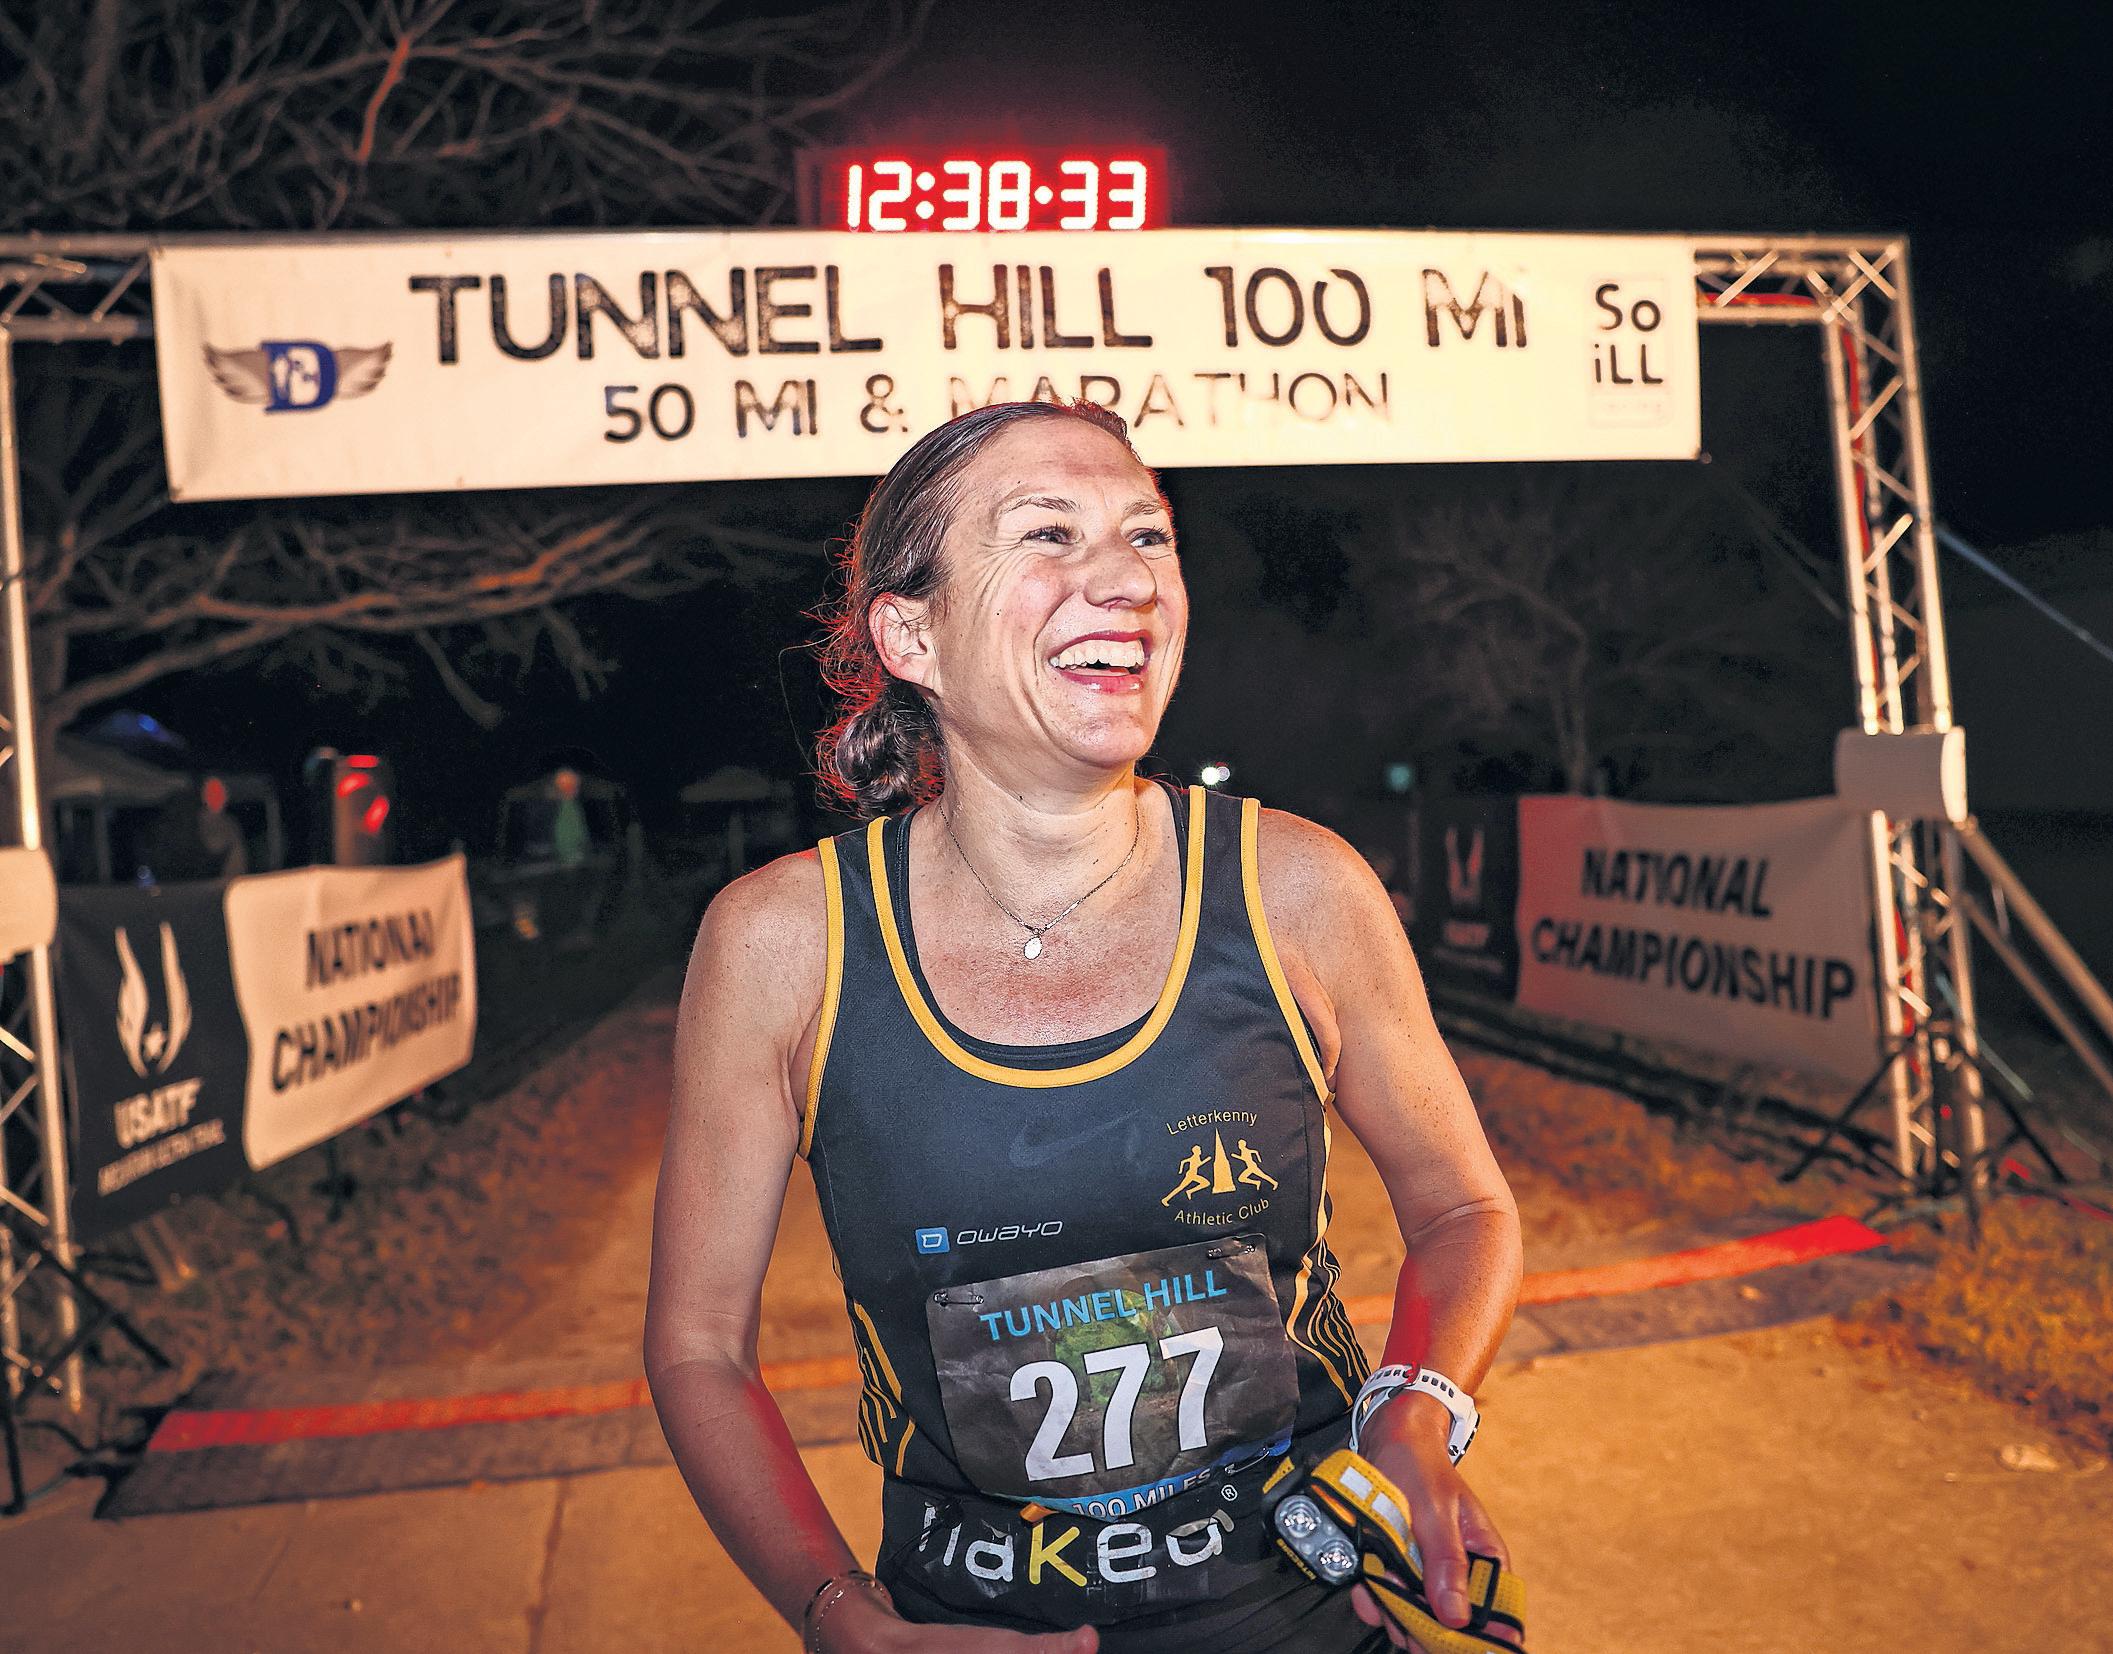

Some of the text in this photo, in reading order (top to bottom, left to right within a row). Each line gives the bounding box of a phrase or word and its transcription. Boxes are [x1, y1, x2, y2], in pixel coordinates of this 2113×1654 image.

[408, 263, 884, 366] TUNNEL
[937, 262, 1153, 350] HILL
[1204, 264, 1371, 349] 100
[1594, 283, 1662, 333] So
[604, 382, 695, 443] 50
[733, 377, 820, 439] MI
[859, 373, 908, 436] &
[1581, 846, 1775, 920] NATIONAL
[1532, 916, 1857, 1019] CHAMPIONSHIP
[1166, 1109, 1258, 1135] Letterkenny
[1174, 1198, 1270, 1226] Athletic Club
[979, 1268, 1228, 1341] TUNNEL HILL
[1008, 1325, 1226, 1483] 277
[1072, 1496, 1128, 1520] 100
